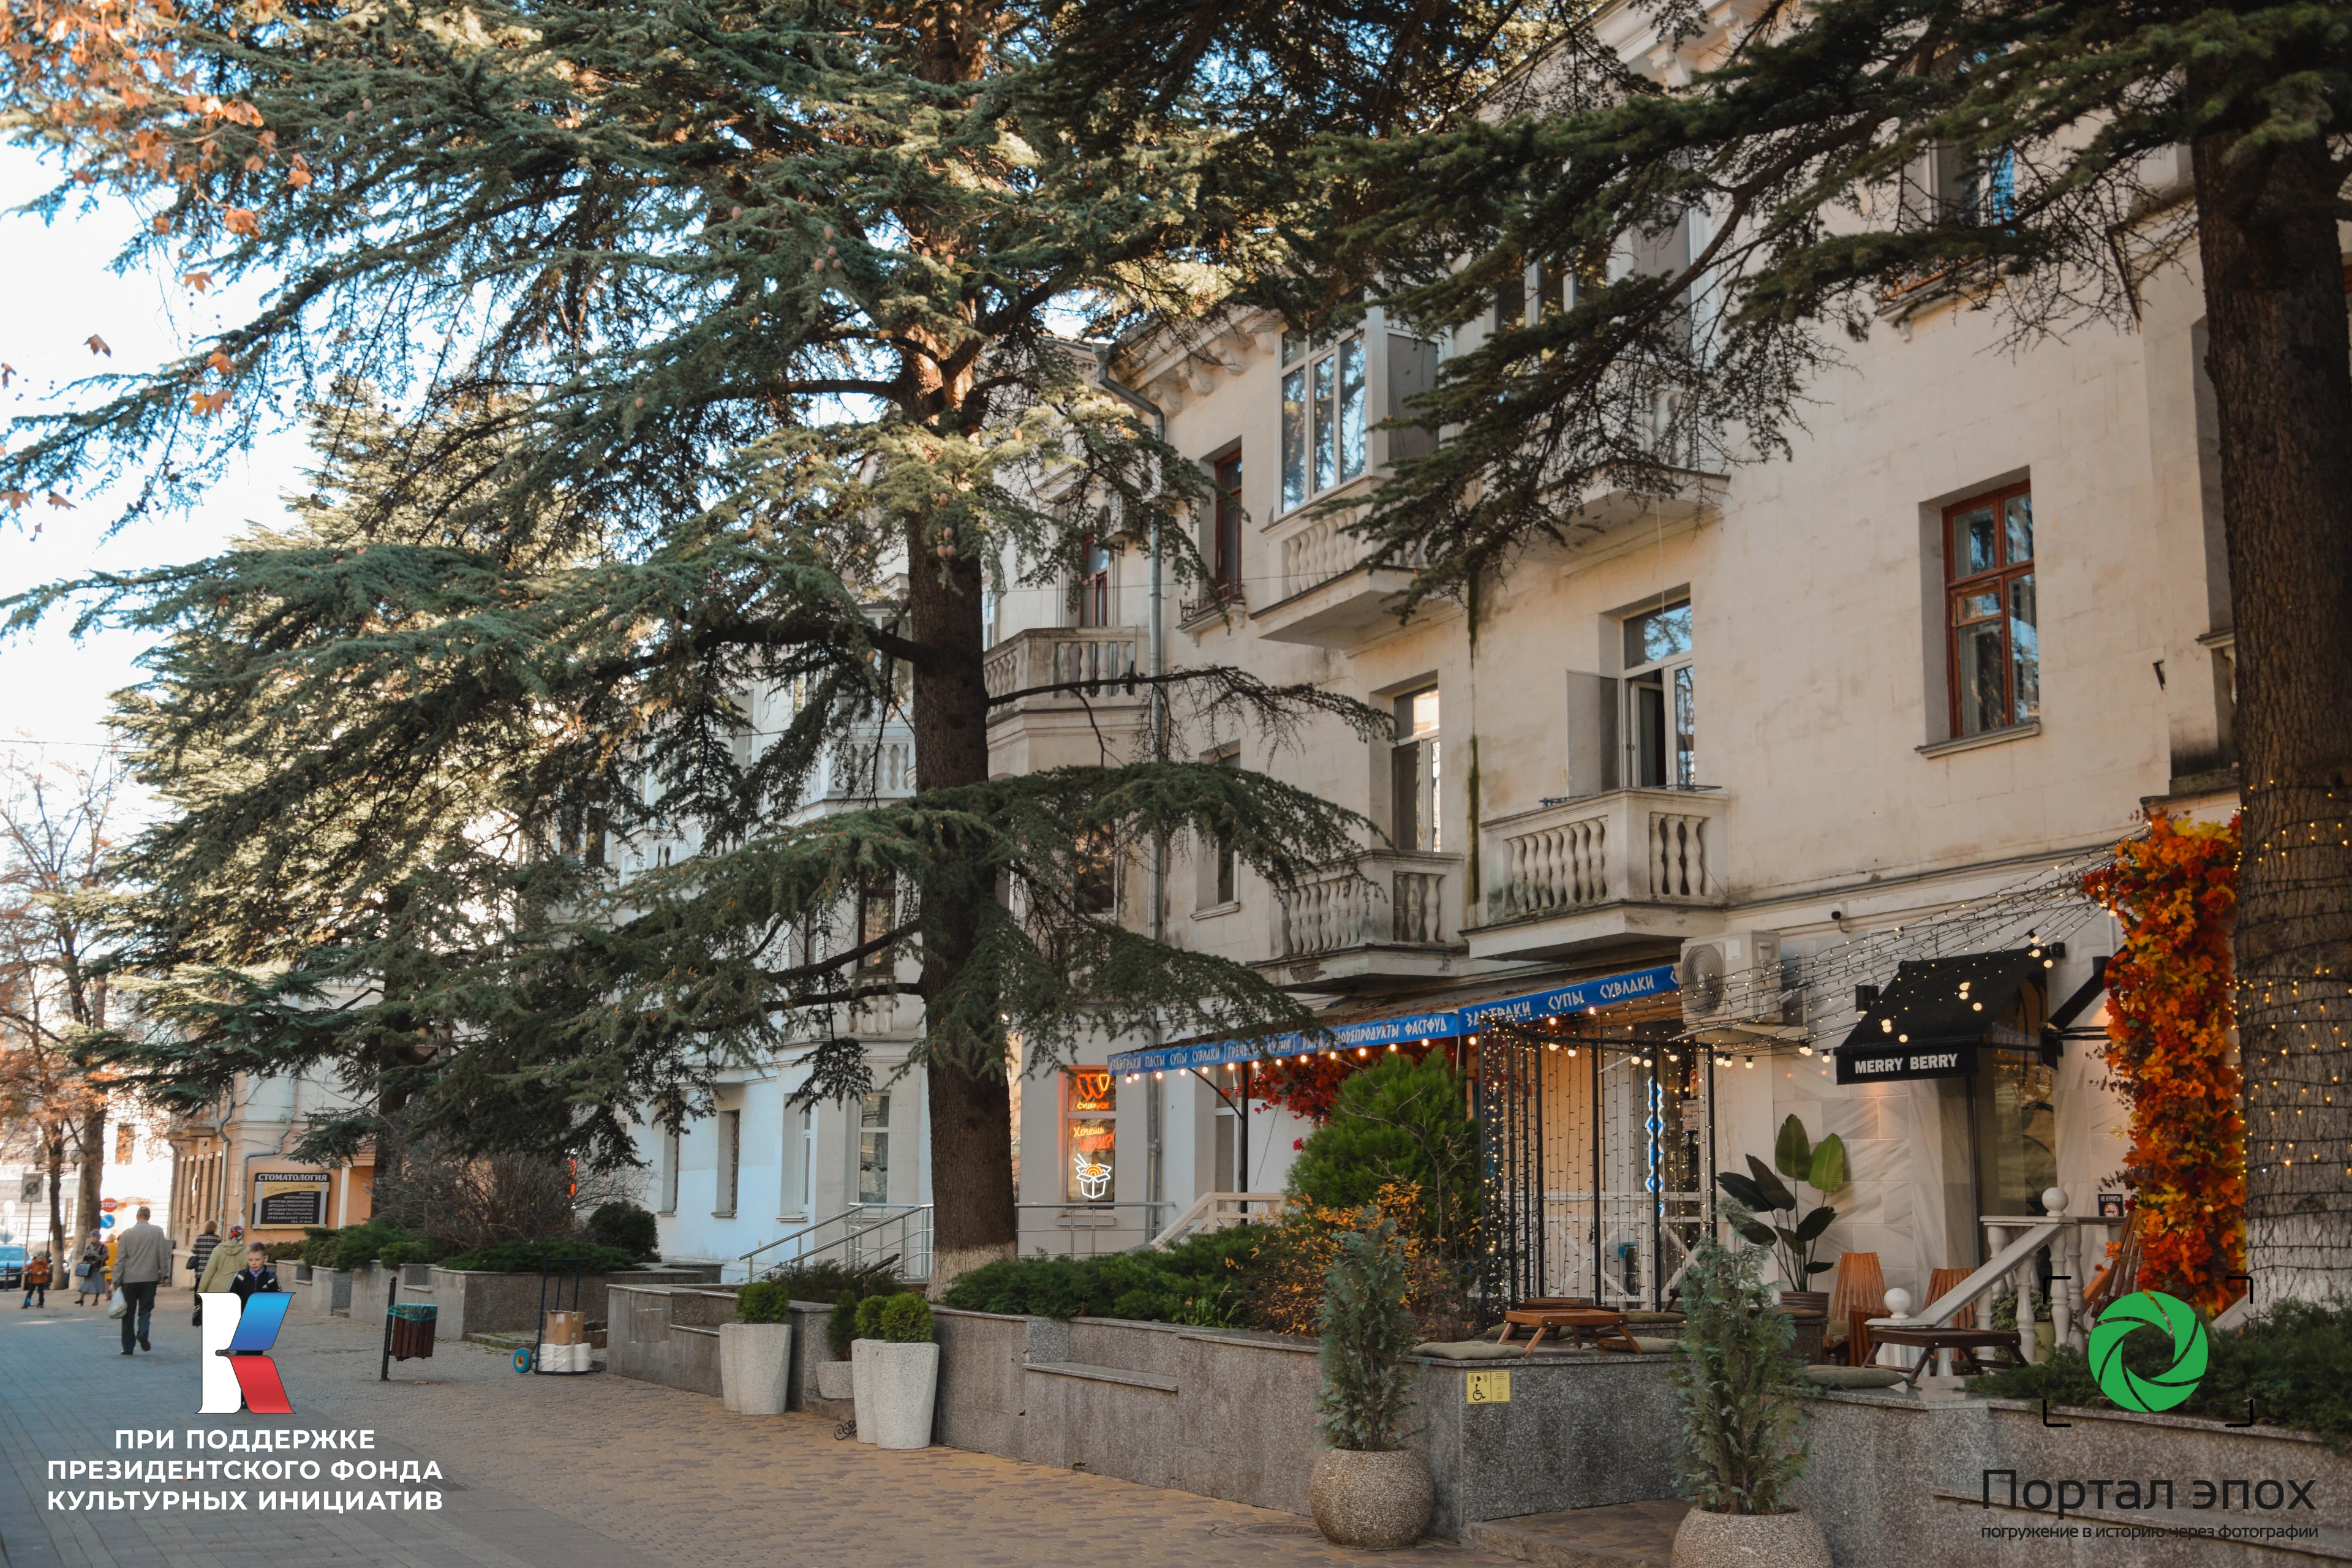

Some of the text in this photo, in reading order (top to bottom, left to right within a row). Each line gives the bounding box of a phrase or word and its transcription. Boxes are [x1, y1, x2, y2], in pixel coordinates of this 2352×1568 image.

[1548, 990, 1583, 1010] СУПЫ
[1599, 974, 1654, 999] СУВЛАКИ
[1111, 1056, 1141, 1071] ЗАВТРАКИ
[1145, 1054, 1165, 1068] ПАСТЫ
[1169, 1052, 1188, 1066] СУПЫ
[1192, 1048, 1219, 1062] СУВЛАКИ
[1404, 1016, 1447, 1036] ФАСТФУД
[1855, 1054, 1958, 1074] MERRY BERRY
